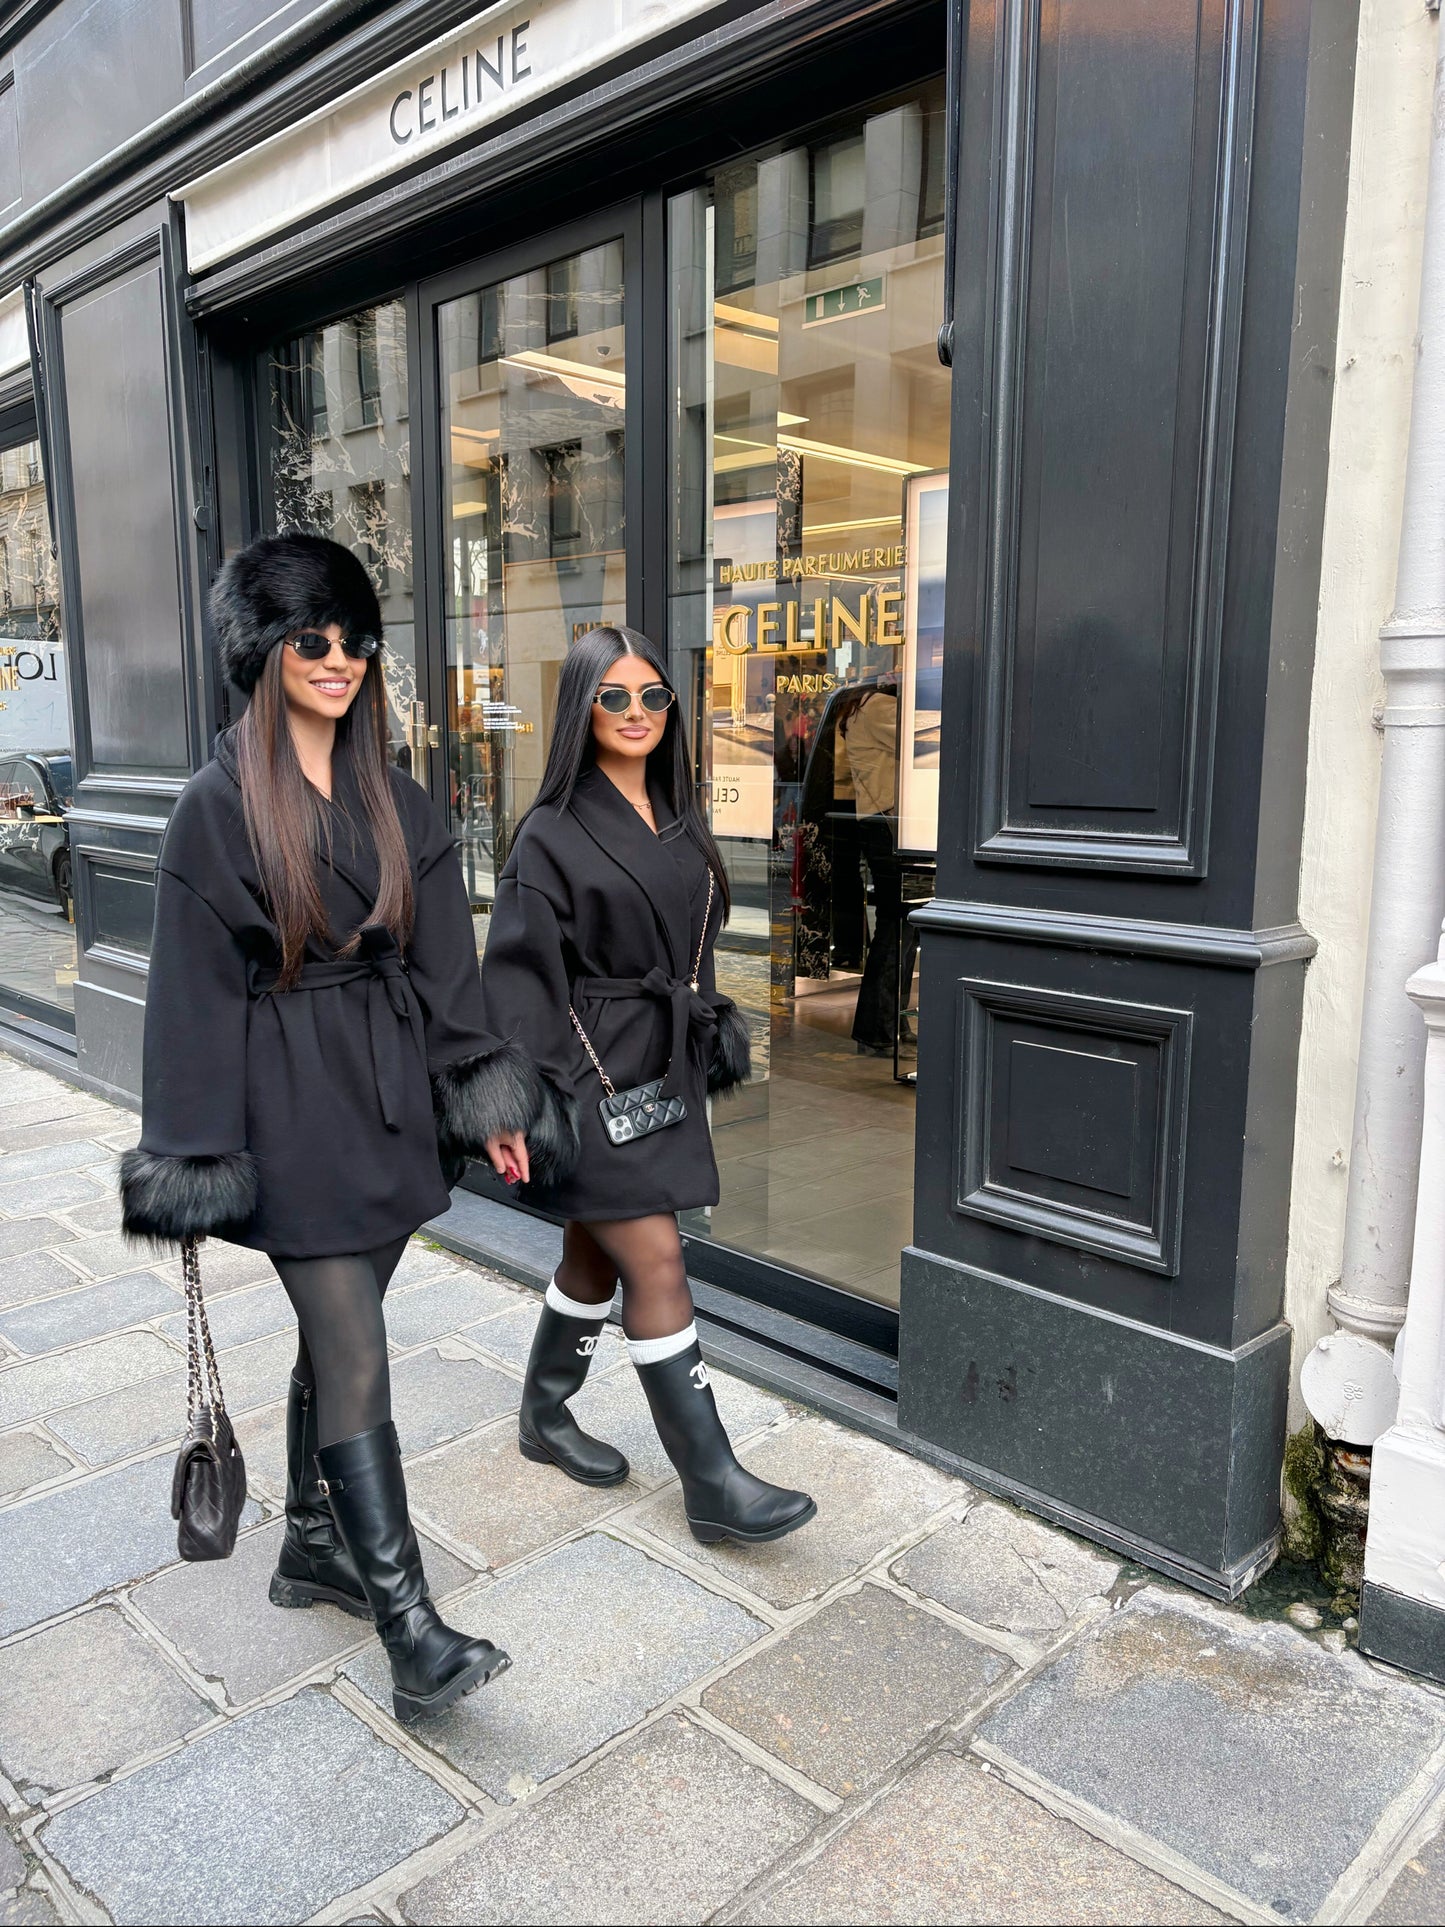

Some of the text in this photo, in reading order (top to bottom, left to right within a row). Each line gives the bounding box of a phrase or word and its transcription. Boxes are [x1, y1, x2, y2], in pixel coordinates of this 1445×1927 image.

[390, 20, 532, 145] CELINE
[720, 545, 908, 584] HAUTE PARFUMERIE
[720, 591, 906, 655] CELINE
[776, 673, 838, 693] PARIS
